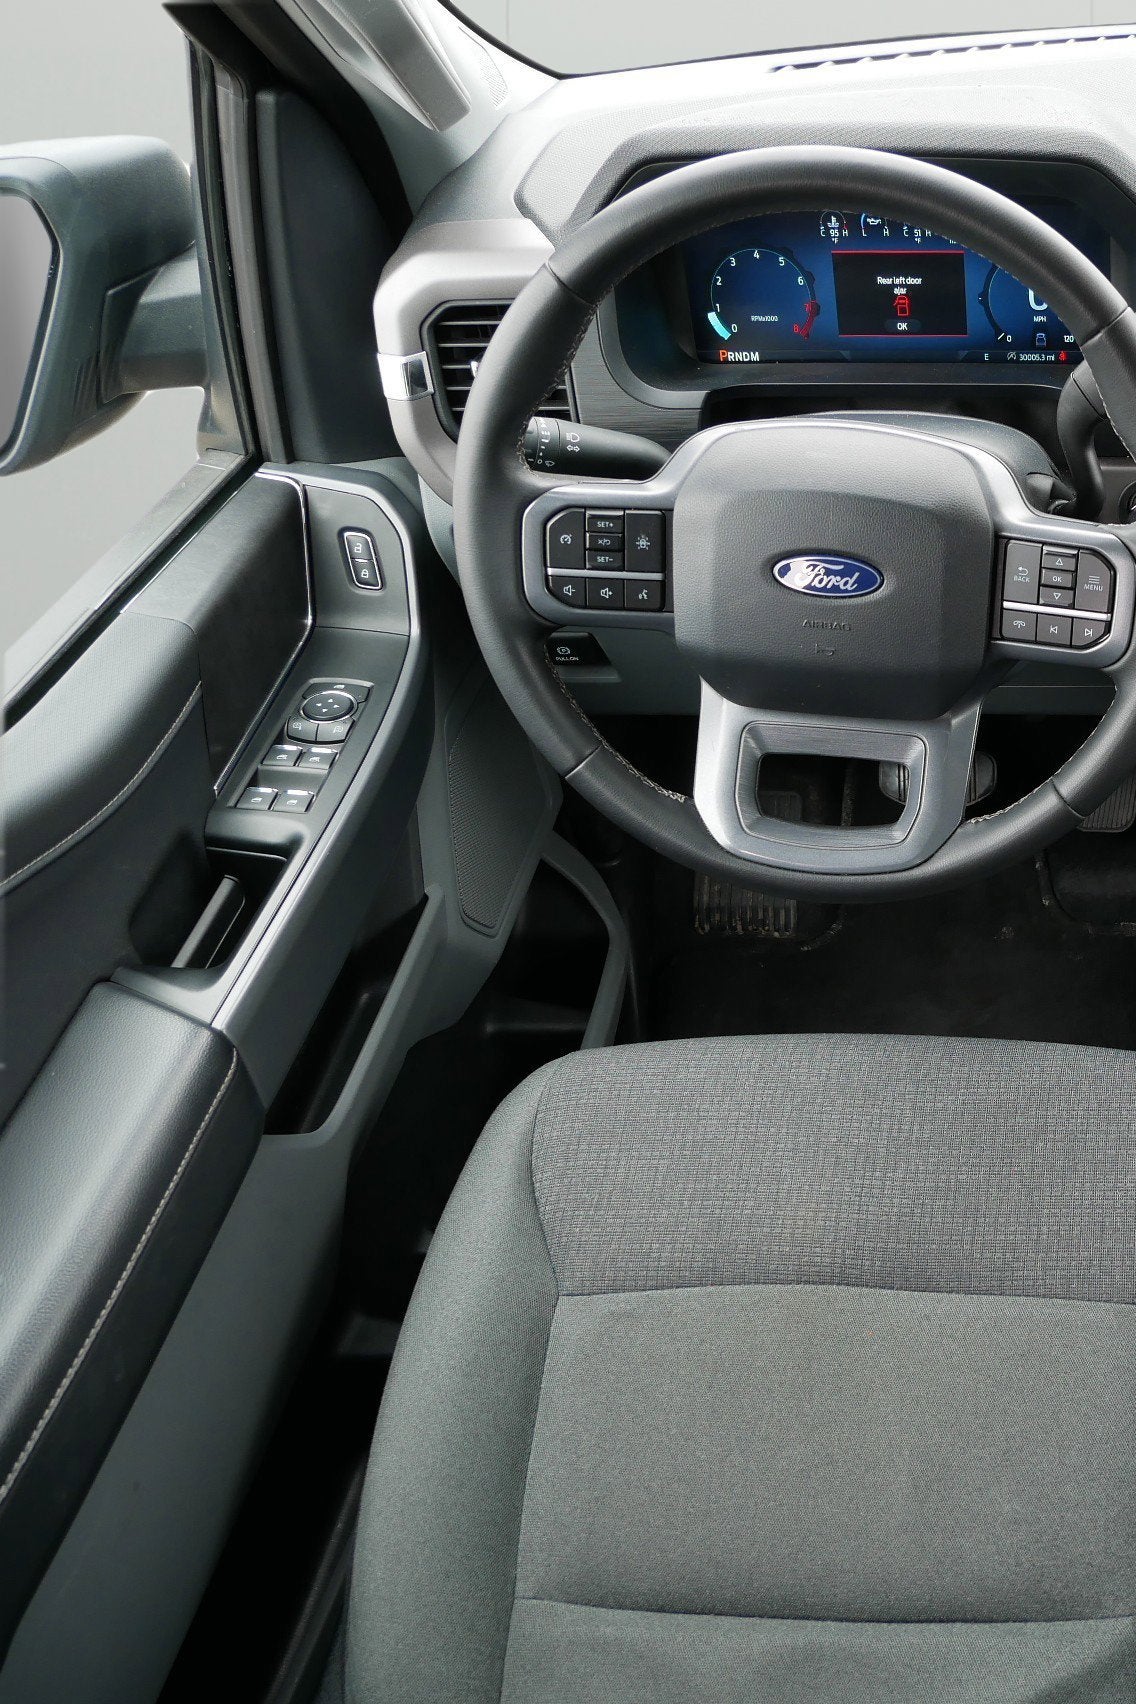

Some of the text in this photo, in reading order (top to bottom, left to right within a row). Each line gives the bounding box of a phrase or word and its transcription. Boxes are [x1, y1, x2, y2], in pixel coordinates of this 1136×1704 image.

[829, 229, 839, 237] 95
[842, 229, 849, 237] H
[862, 229, 890, 237] L H
[753, 249, 760, 260] 4
[729, 257, 736, 266] 3
[778, 257, 785, 266] 5
[715, 276, 722, 286] 2
[797, 276, 804, 286] 6
[877, 276, 922, 285] Rear left door
[715, 303, 720, 312] 1
[731, 323, 738, 333] 0
[897, 322, 908, 331] OK
[1006, 335, 1012, 343] 0
[1063, 335, 1074, 343] 120
[719, 349, 760, 362] PRNDM
[984, 353, 989, 361] E
[785, 560, 861, 591] Ford
[1013, 575, 1031, 583] BACK
[1052, 575, 1063, 583] OK
[1083, 584, 1104, 592] MENU
[802, 619, 852, 632] AIRBAG
